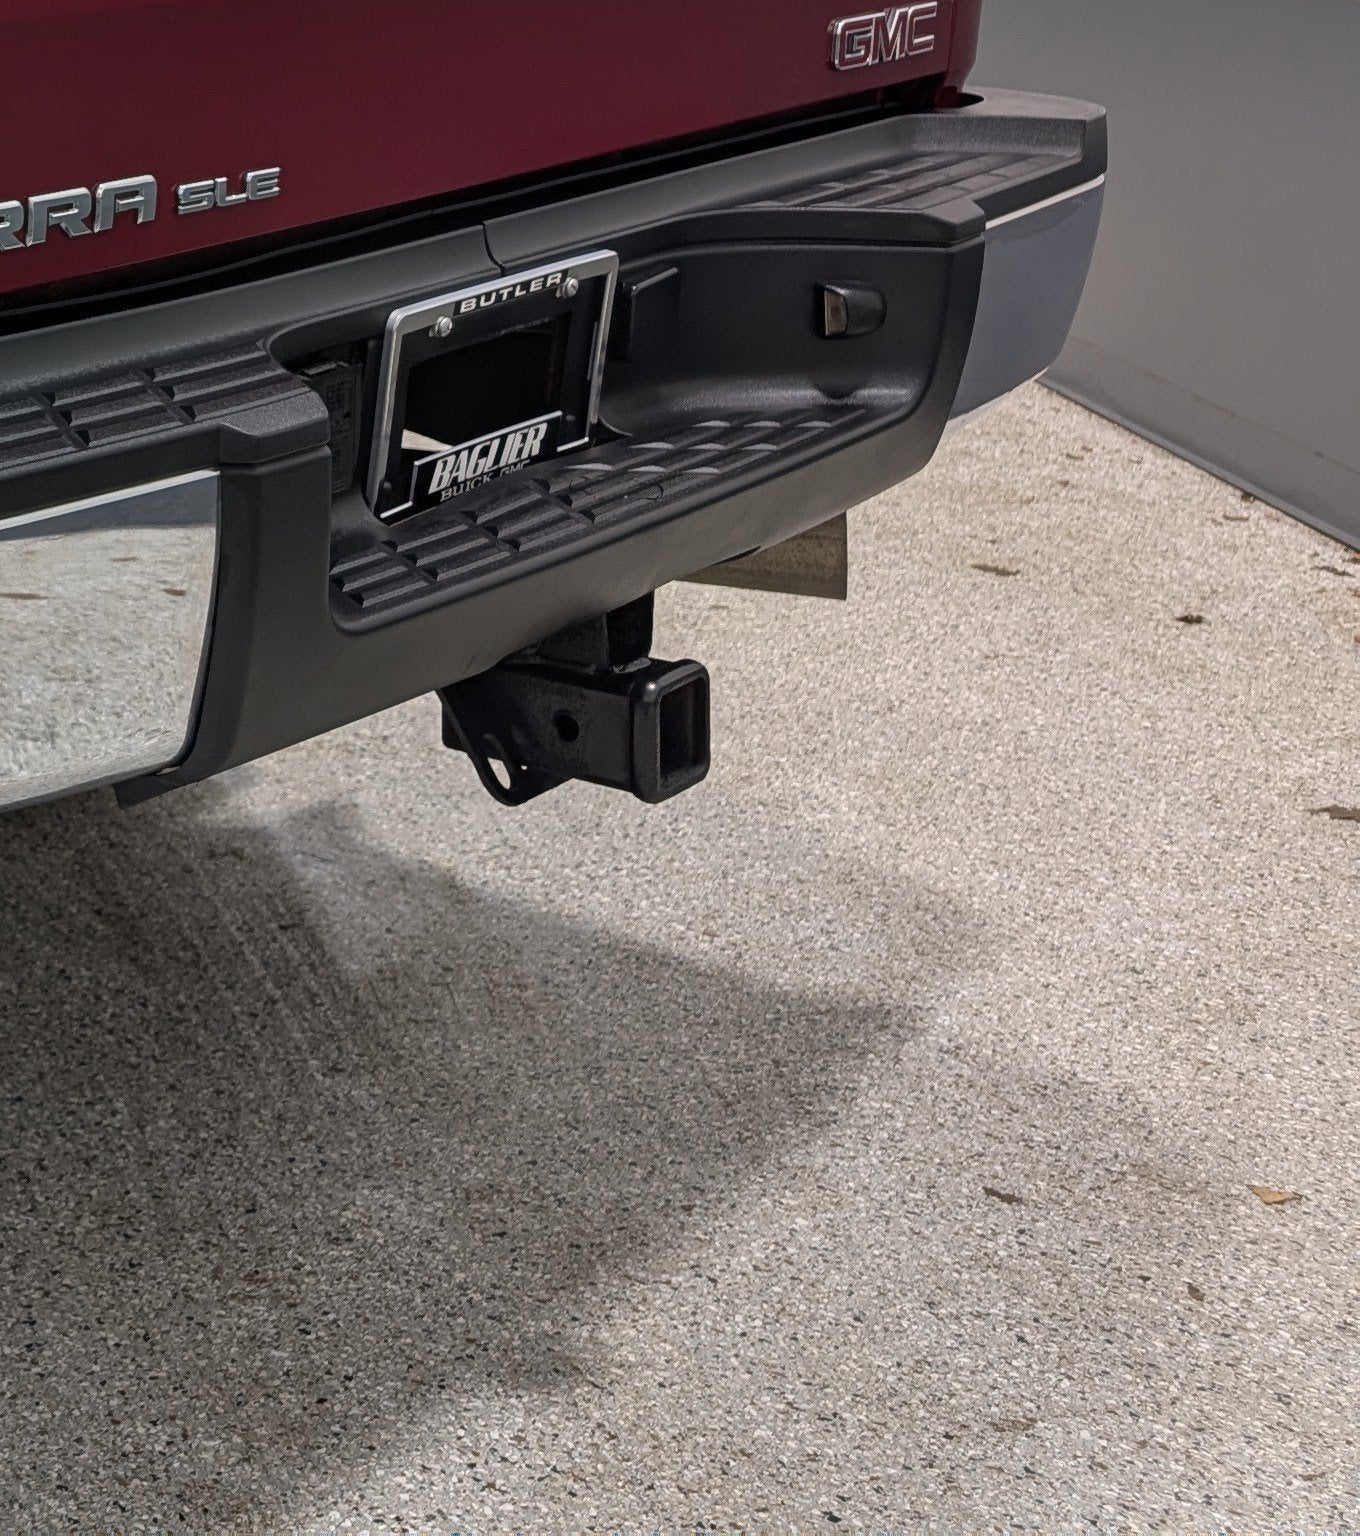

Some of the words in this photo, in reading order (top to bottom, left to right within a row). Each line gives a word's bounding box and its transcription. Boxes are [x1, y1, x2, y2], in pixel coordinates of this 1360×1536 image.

[831, 0, 938, 71] GMC
[177, 166, 281, 215] SLE
[459, 272, 564, 314] BUTLER
[427, 422, 548, 496] BAGLIER
